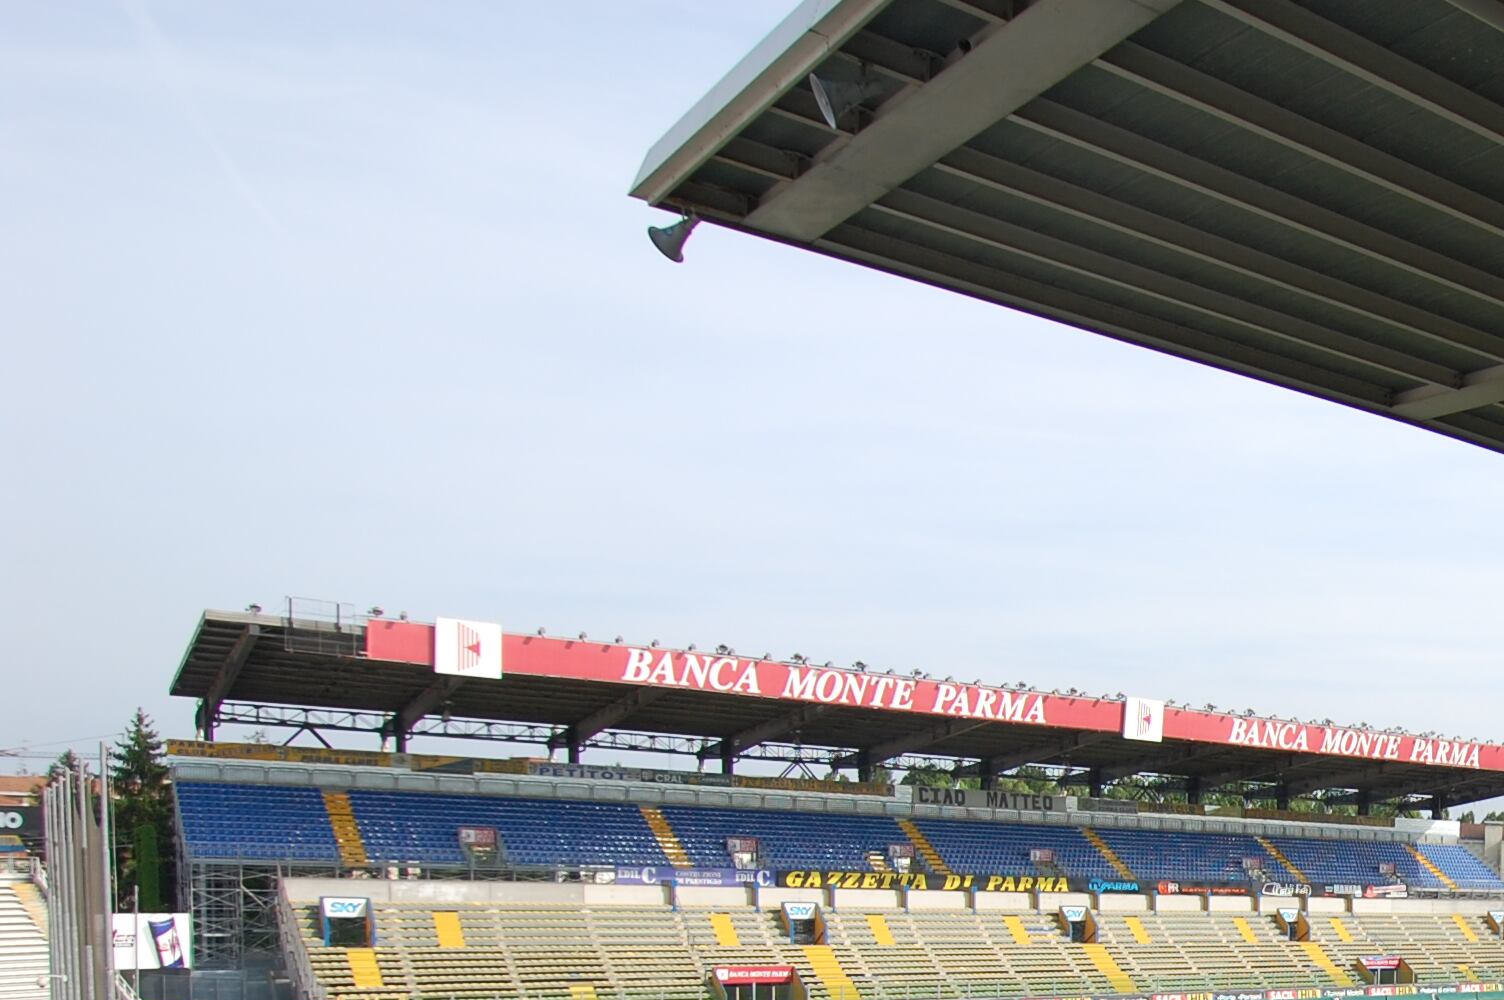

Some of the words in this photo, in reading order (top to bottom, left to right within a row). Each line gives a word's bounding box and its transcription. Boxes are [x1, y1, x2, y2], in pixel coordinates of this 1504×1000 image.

[621, 647, 761, 694] BANCA
[782, 665, 915, 709] MONTE
[930, 682, 1048, 725] PARMA
[1228, 717, 1309, 751] BANCA
[1320, 727, 1402, 760] MONTE
[1409, 738, 1481, 769] PARMA
[538, 766, 627, 781] PETITOT
[655, 773, 684, 784] CRAL
[918, 786, 966, 806] CIAO
[986, 791, 1054, 811] MATTEO
[785, 870, 928, 890] GAZZETTA
[985, 875, 1070, 893] PARMA
